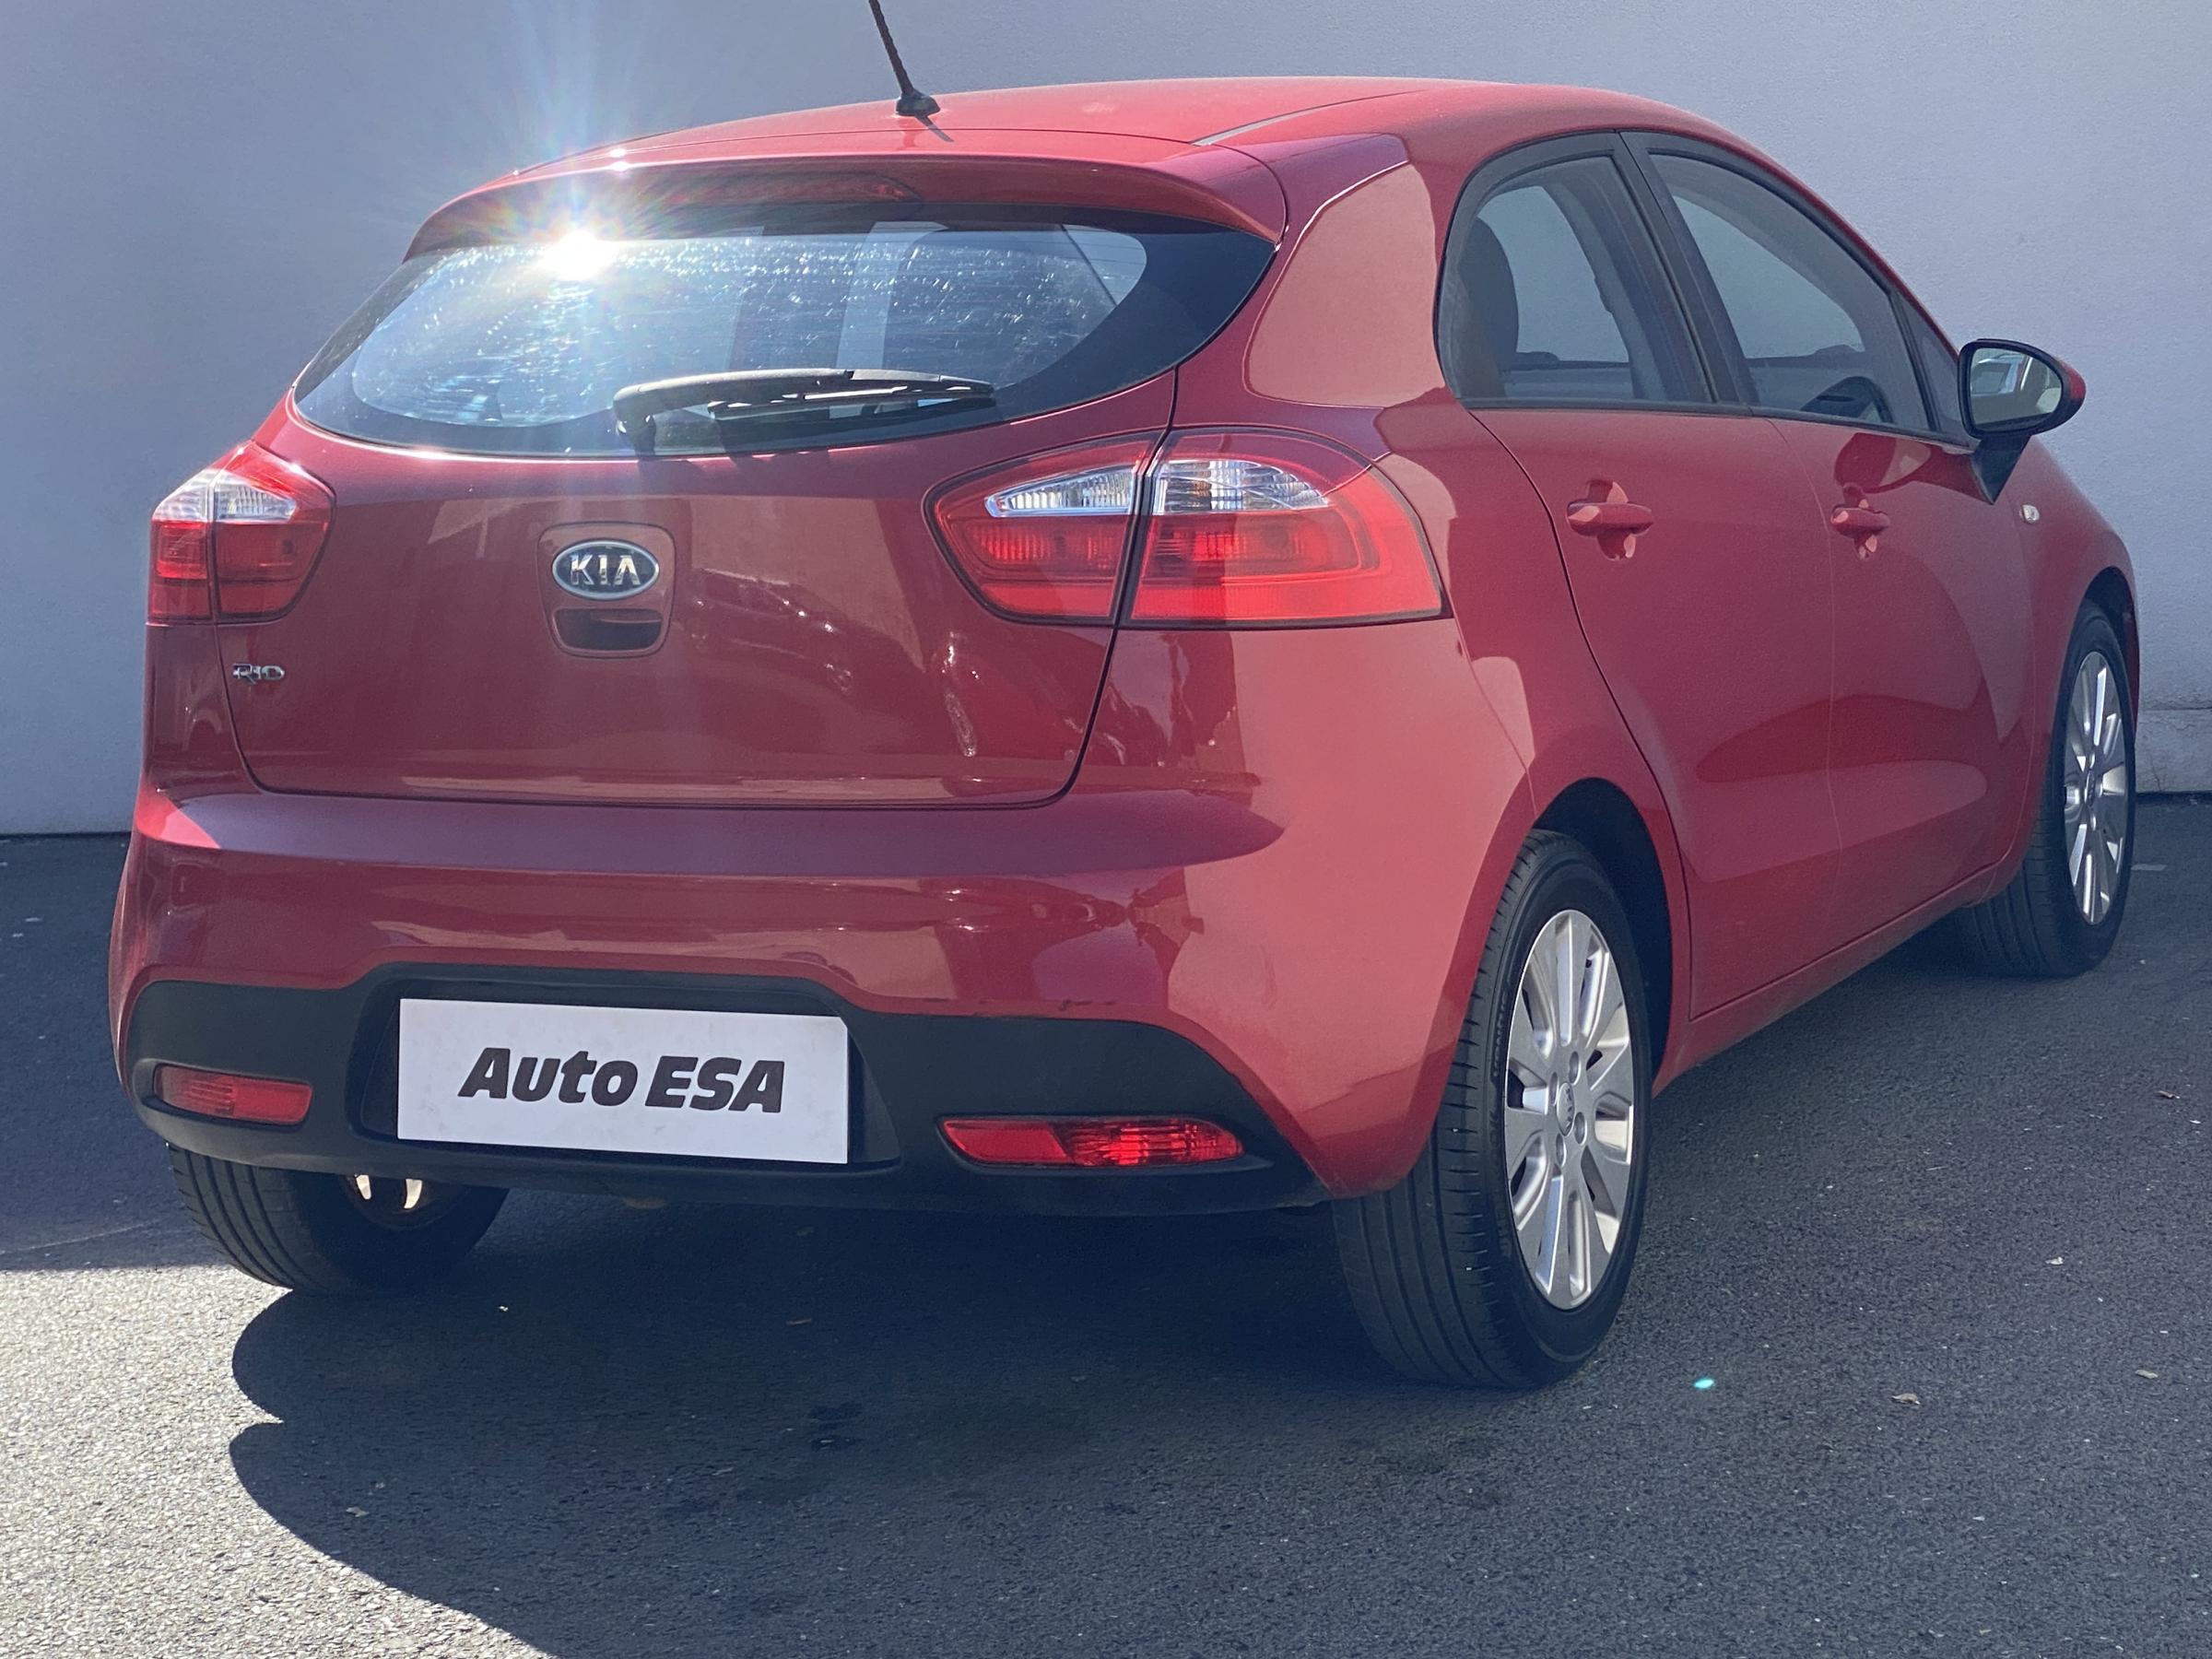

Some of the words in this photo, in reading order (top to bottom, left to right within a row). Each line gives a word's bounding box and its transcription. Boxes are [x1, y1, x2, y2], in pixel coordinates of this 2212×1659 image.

[569, 554, 641, 585] KIA
[457, 1047, 638, 1106] Auto
[645, 1055, 784, 1113] ESA
